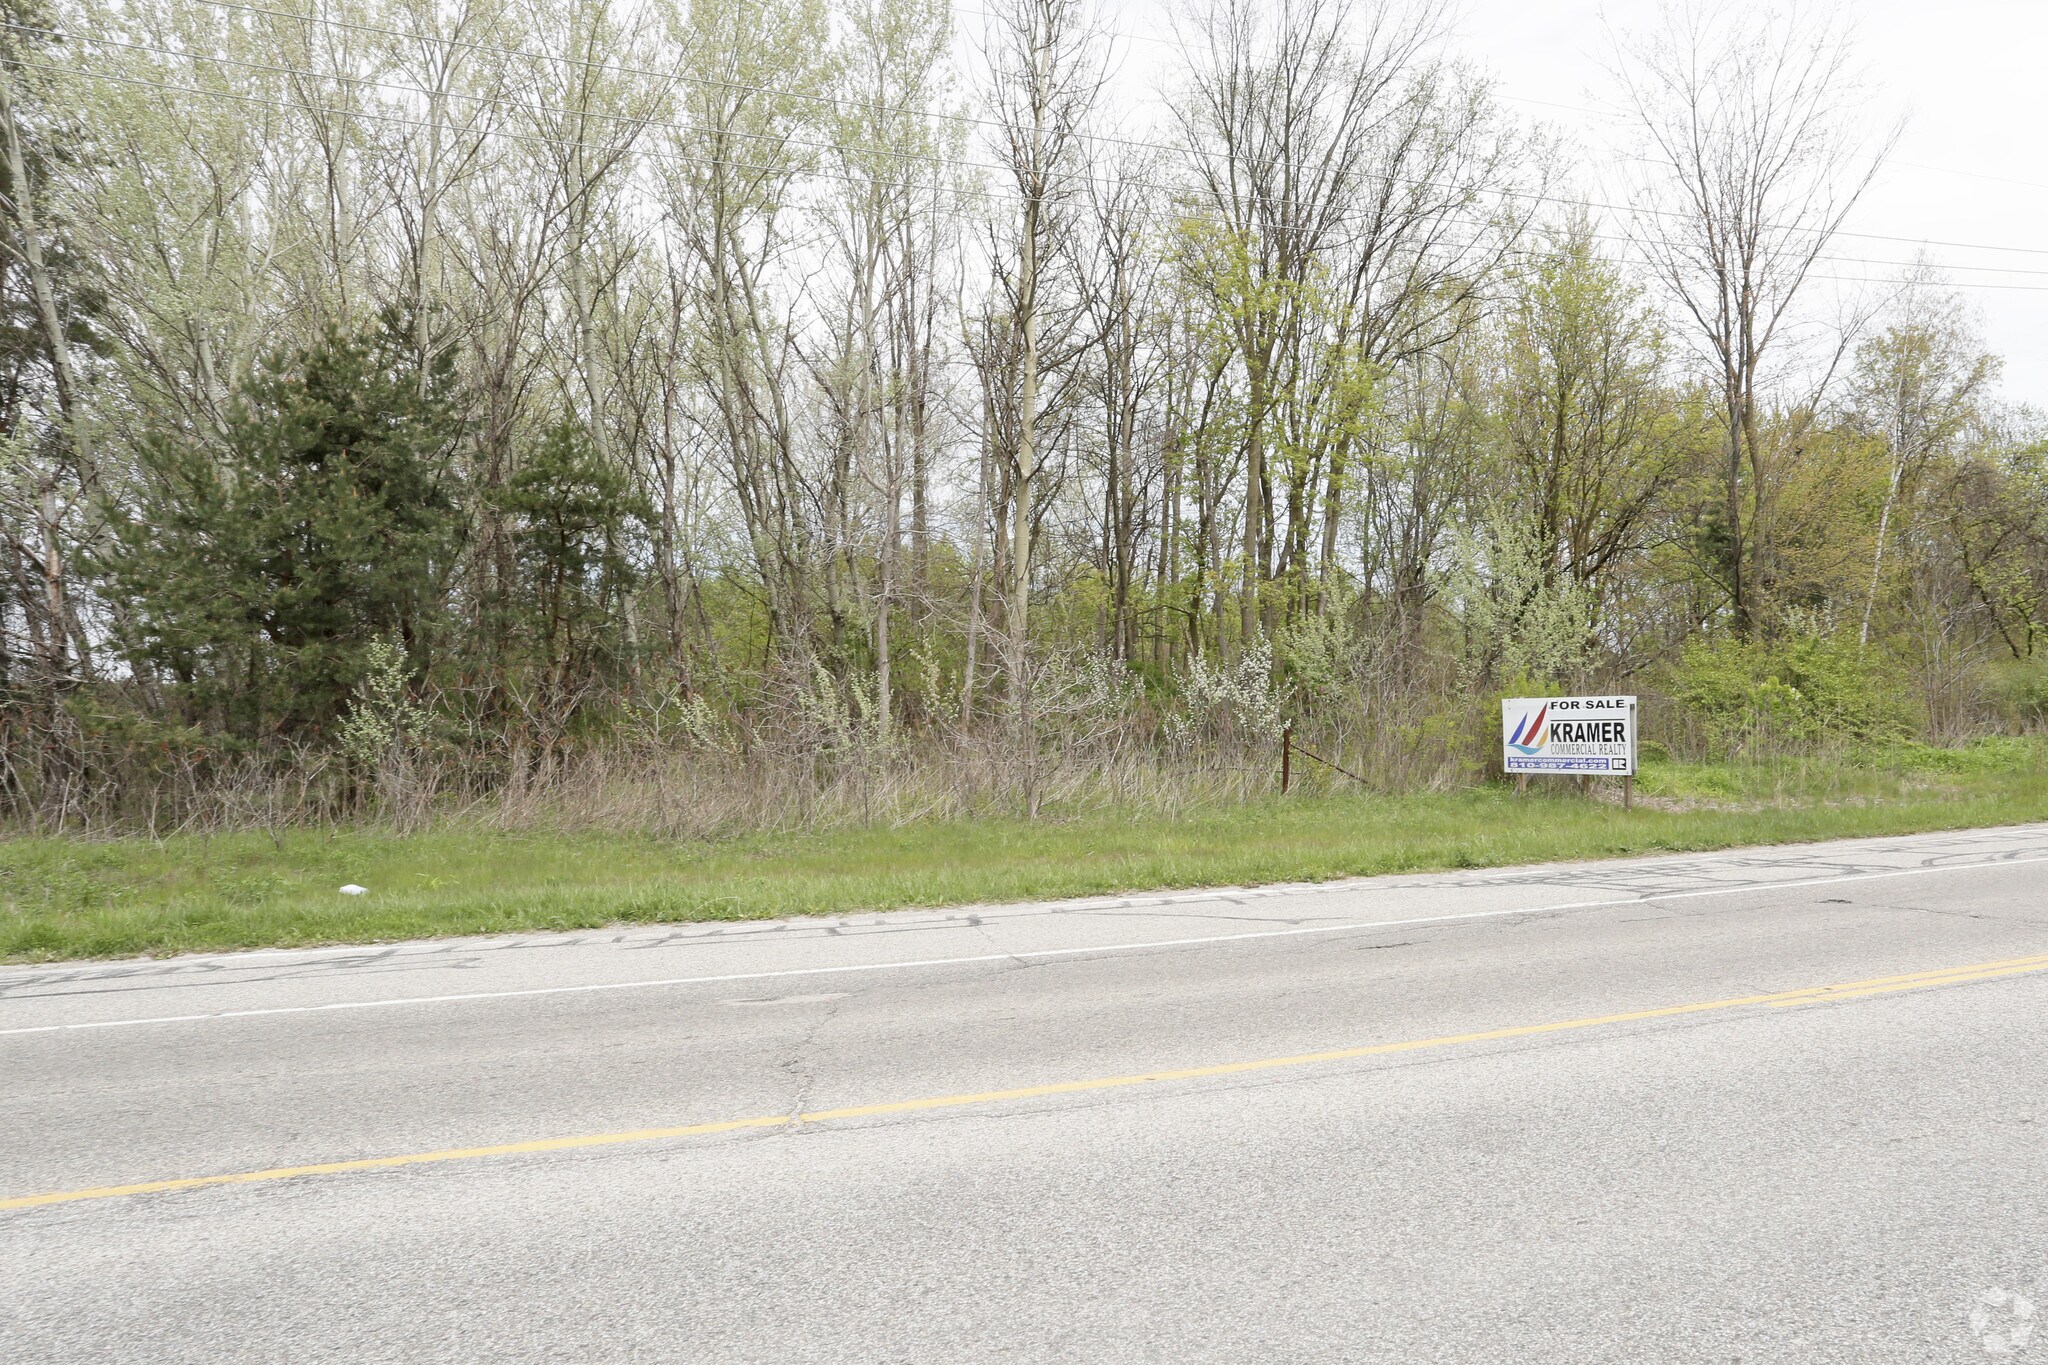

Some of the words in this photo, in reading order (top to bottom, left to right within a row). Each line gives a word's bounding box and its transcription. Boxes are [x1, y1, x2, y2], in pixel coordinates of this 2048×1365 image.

[1551, 701, 1580, 710] FOR
[1586, 699, 1625, 709] SALE
[1550, 722, 1626, 743] KRAMER
[1551, 744, 1597, 756] COMMERCIAL
[1599, 743, 1627, 756] REALTY
